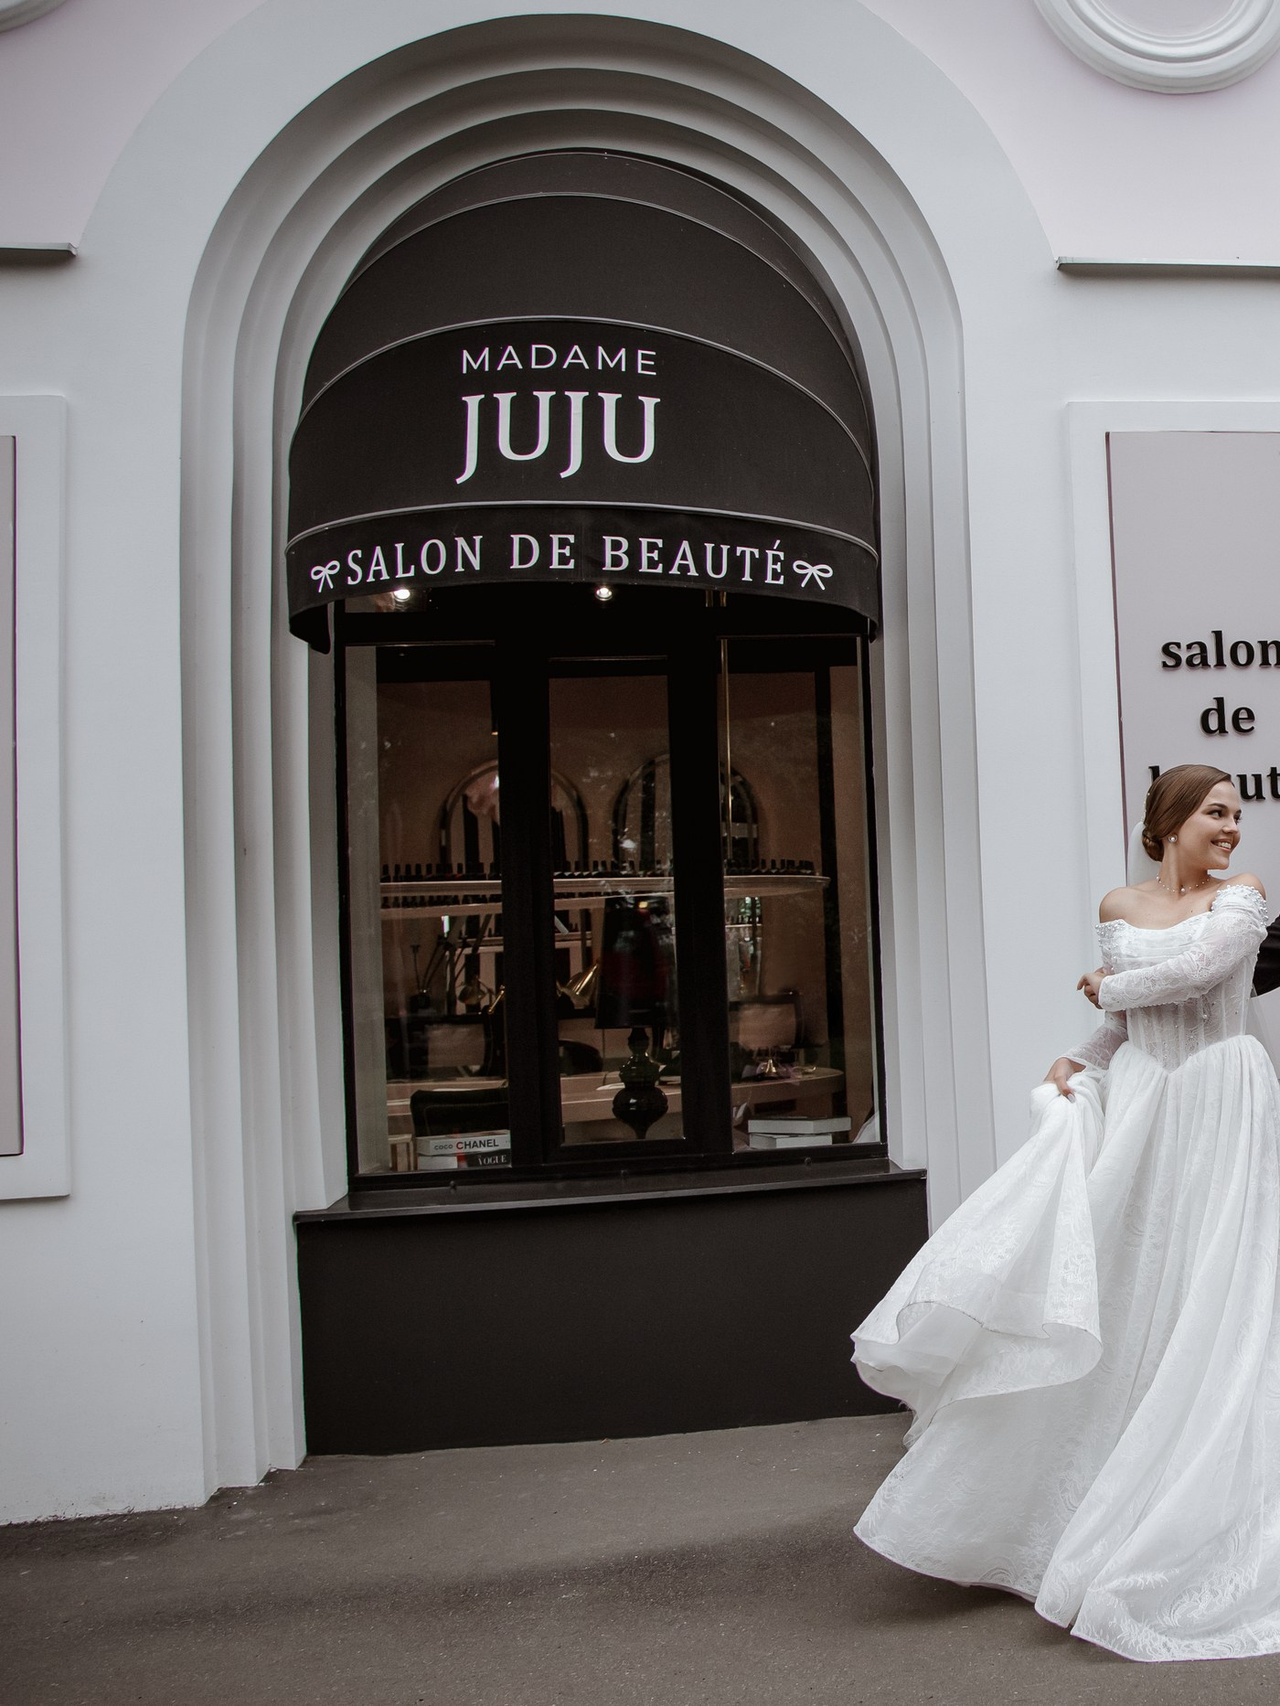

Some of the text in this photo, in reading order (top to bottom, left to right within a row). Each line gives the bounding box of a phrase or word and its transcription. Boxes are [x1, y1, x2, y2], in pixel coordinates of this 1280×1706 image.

[462, 344, 657, 376] MADAME
[456, 390, 661, 485] JUJU
[347, 534, 785, 585] SALON DE BEAUTÉ
[1200, 696, 1256, 735] de
[456, 1139, 499, 1150] CHANEL
